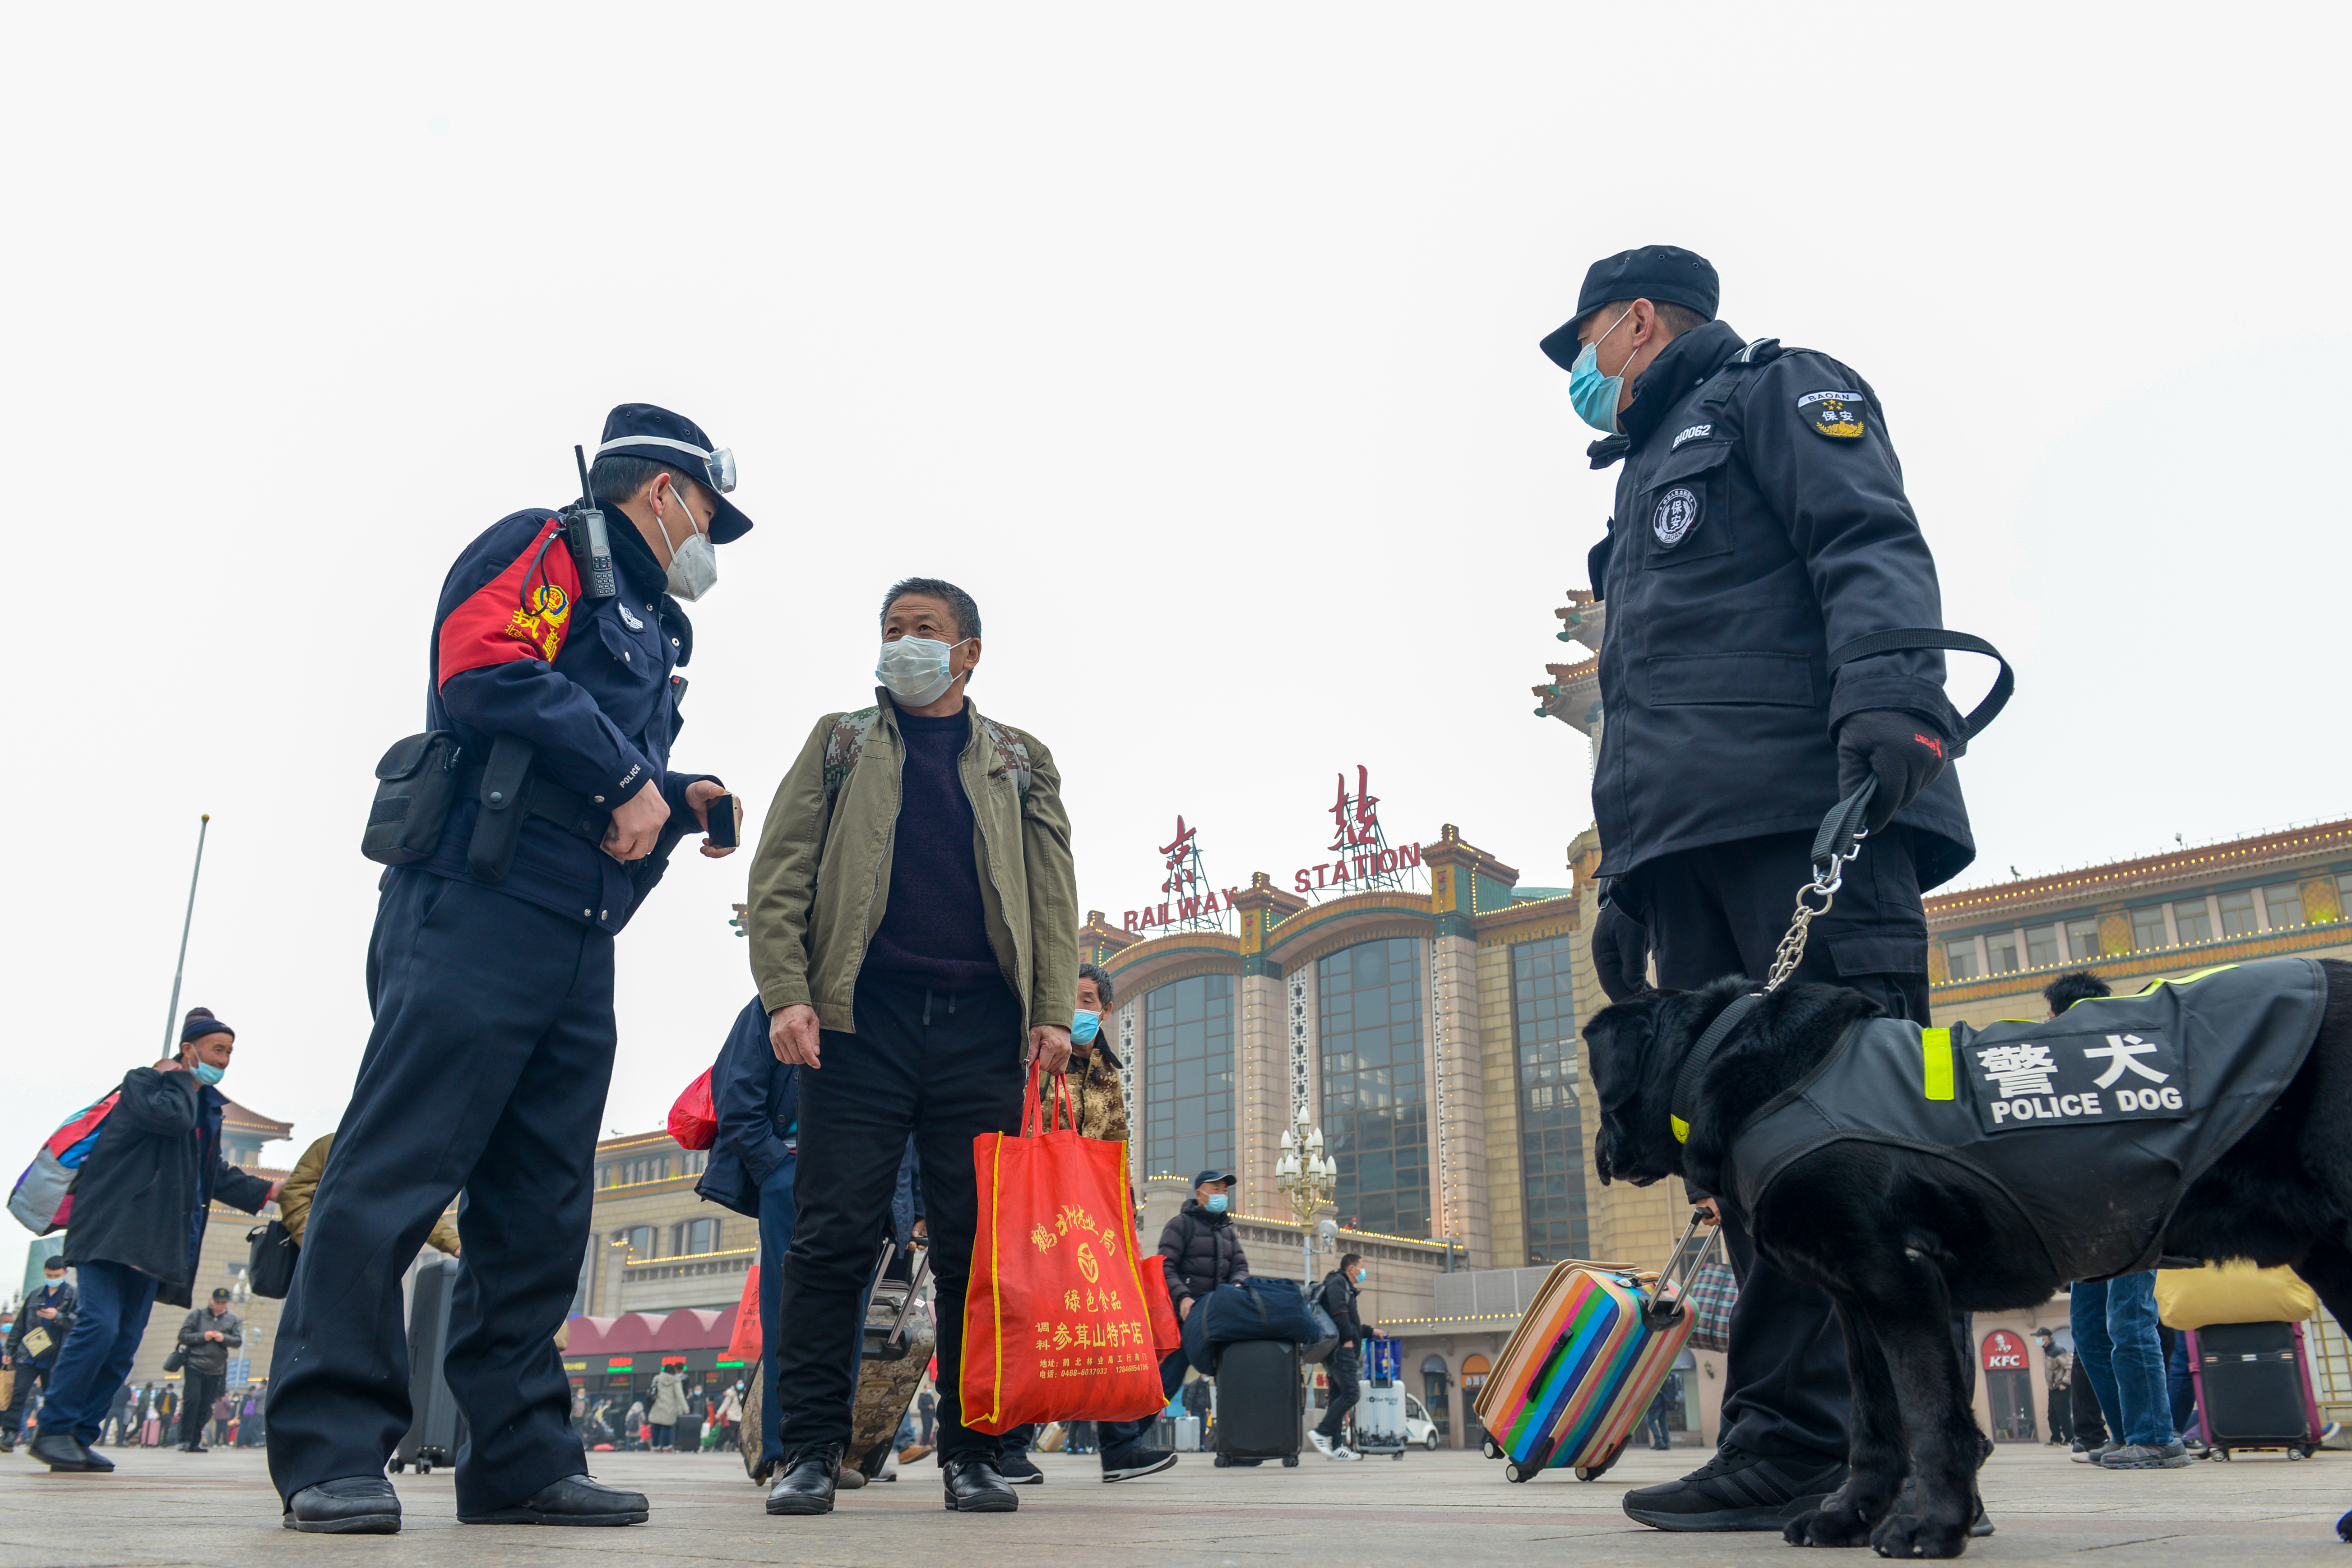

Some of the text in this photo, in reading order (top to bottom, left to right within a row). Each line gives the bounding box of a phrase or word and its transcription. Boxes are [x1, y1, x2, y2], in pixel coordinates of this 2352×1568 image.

[1807, 393, 1850, 401] BAOAN
[1822, 411, 1854, 421] 保安
[1672, 424, 1711, 449] BA0062
[1670, 500, 1682, 529] 保安
[1664, 530, 1683, 541] BAOAN
[619, 763, 641, 788] POLICE
[1124, 842, 1421, 933] RAILWAY STATION
[1977, 1034, 2169, 1098] 警犬
[1991, 1087, 2184, 1124] POLICE DOG
[1064, 1287, 1122, 1313] 绿色食品
[1052, 1319, 1144, 1351] 参茸山特产店
[1989, 1355, 2021, 1367] KFC
